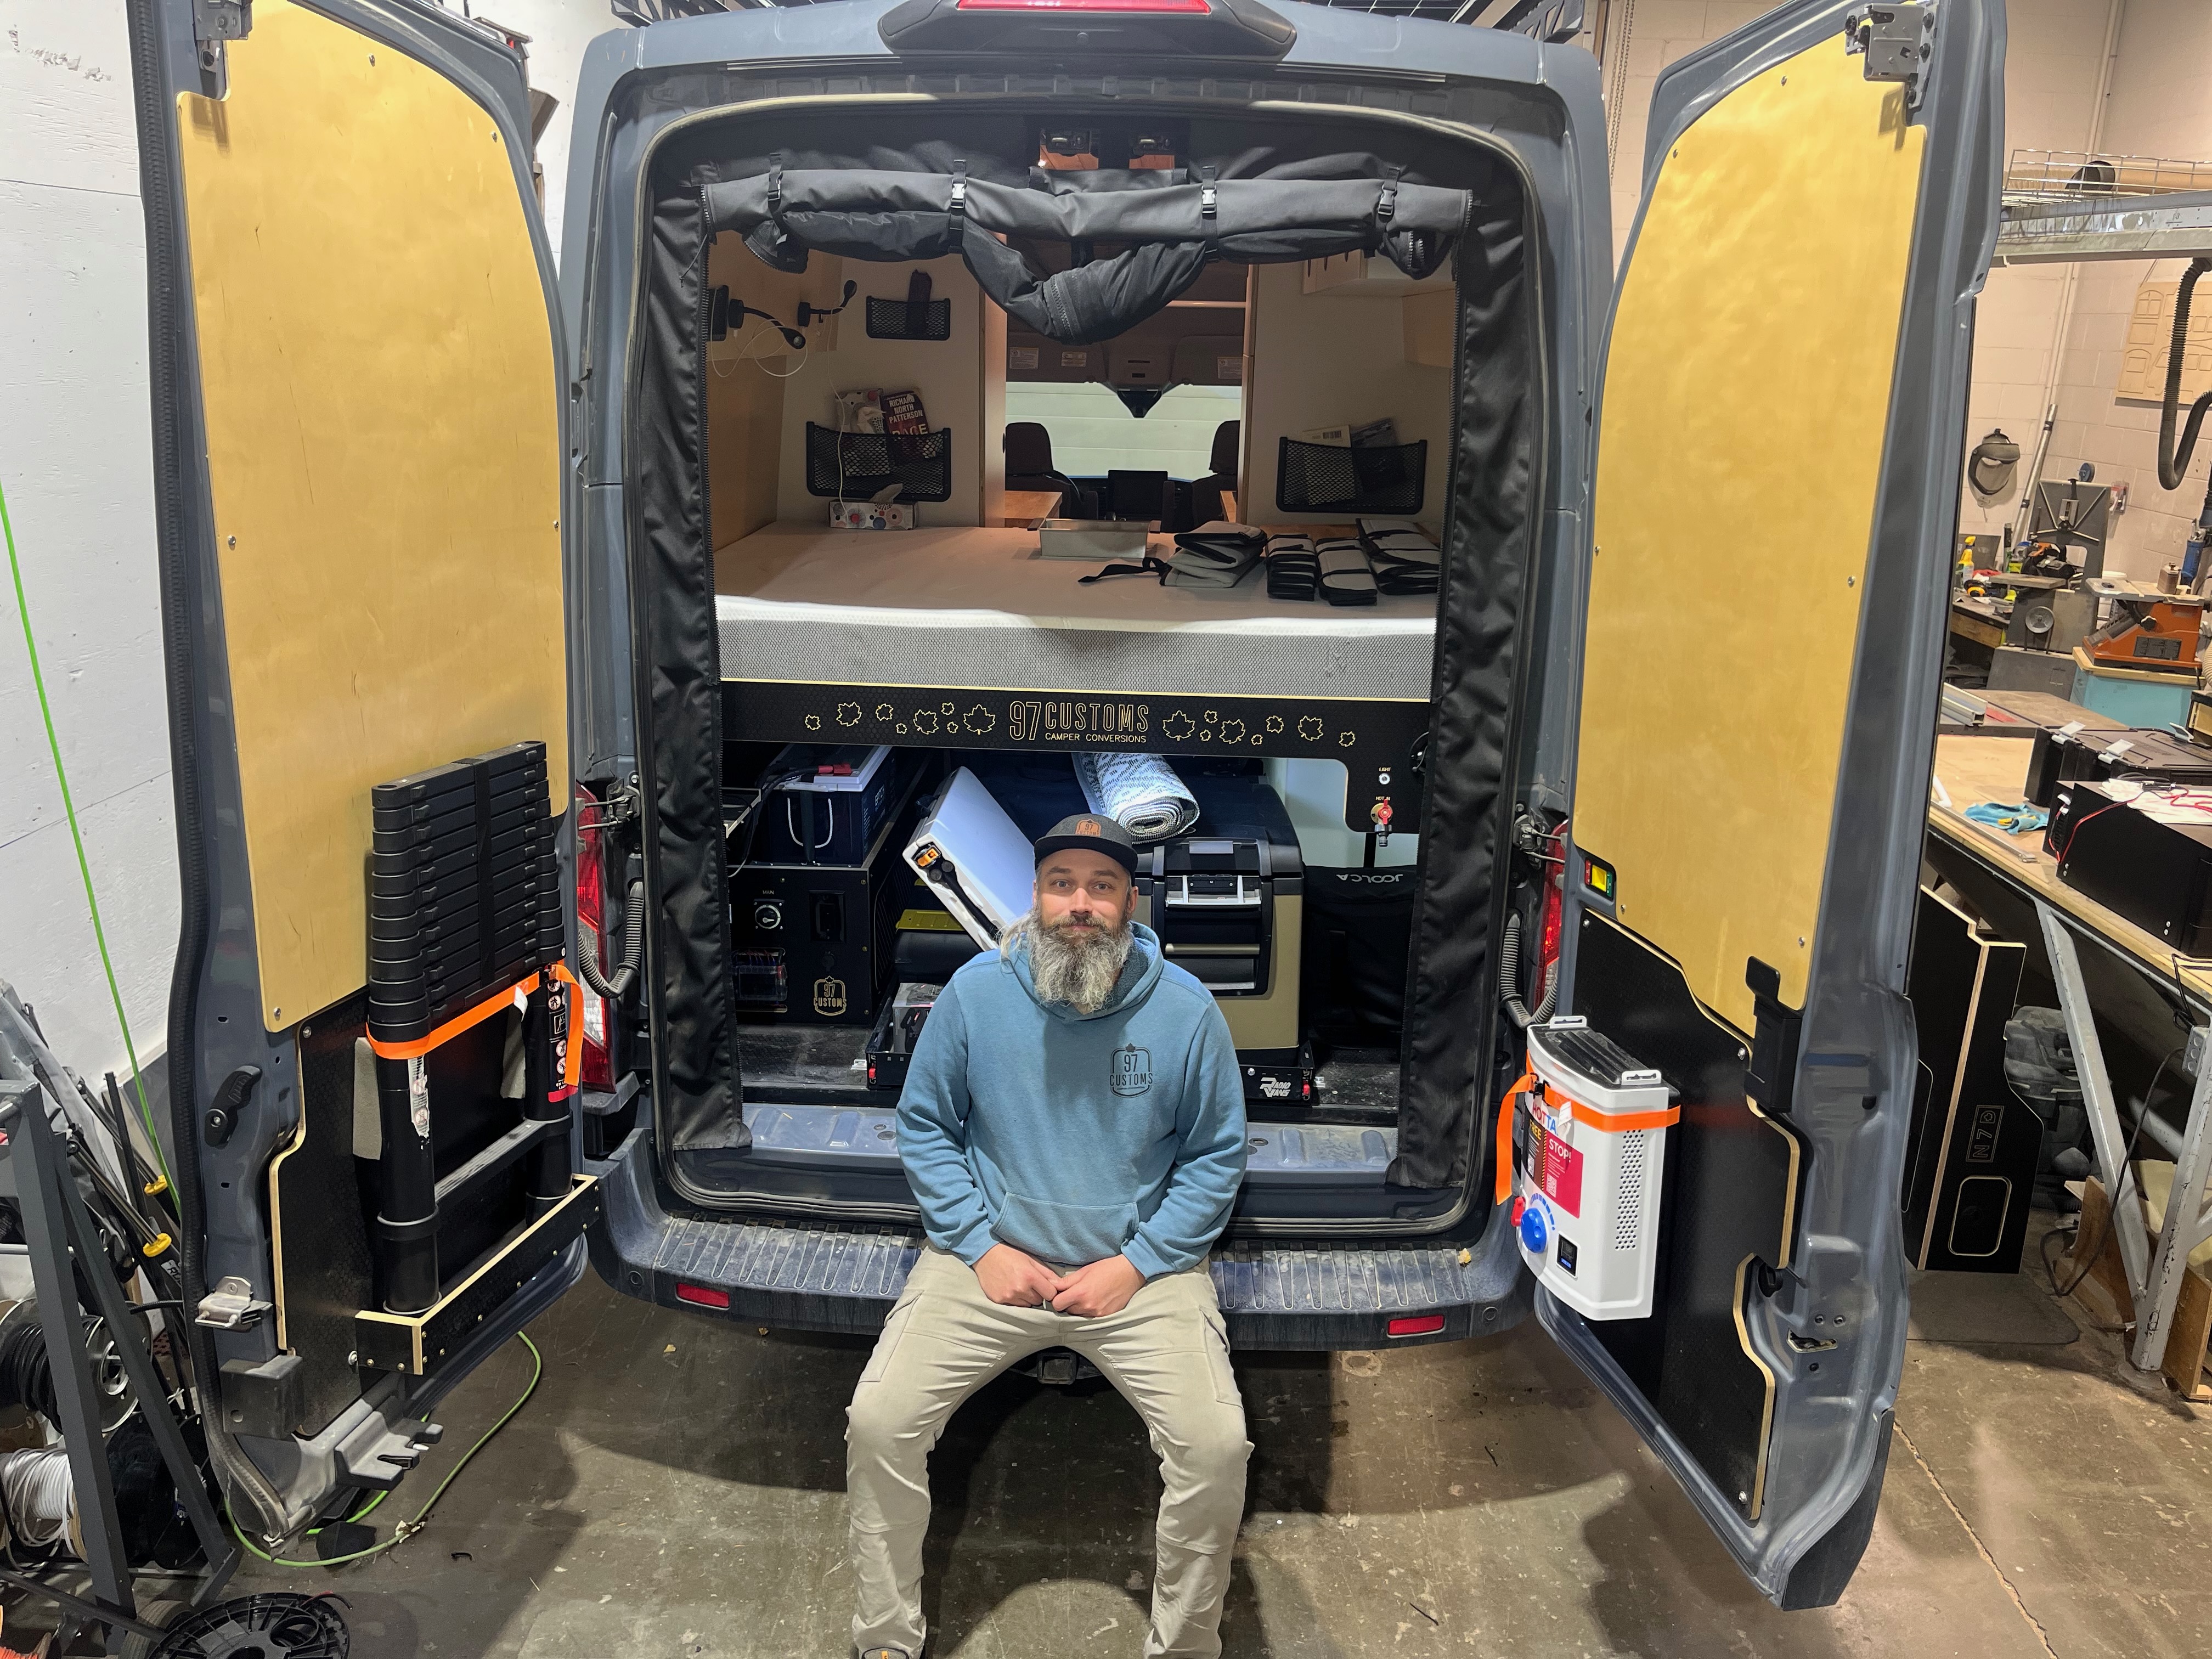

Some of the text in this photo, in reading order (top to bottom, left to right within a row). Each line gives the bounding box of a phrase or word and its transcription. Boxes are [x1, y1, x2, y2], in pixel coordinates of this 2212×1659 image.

[889, 394, 915, 407] RICHARD
[894, 403, 914, 414] NORTH
[889, 409, 923, 424] PATTERSON
[1009, 701, 1149, 741] 97 CUSTOMS
[1045, 732, 1147, 743] CAMPER CONVERSIONS
[1335, 873, 1404, 883] JOOLCA
[823, 983, 836, 997] 97
[813, 997, 847, 1007] CUSTOMS
[1124, 1054, 1138, 1073] 97
[1110, 1073, 1153, 1086] CUSTOMS
[1263, 1087, 1291, 1098] VANS
[1532, 1102, 1559, 1136] HOTTA
[1530, 1119, 1542, 1141] FREE
[1548, 1138, 1572, 1164] STOP!
